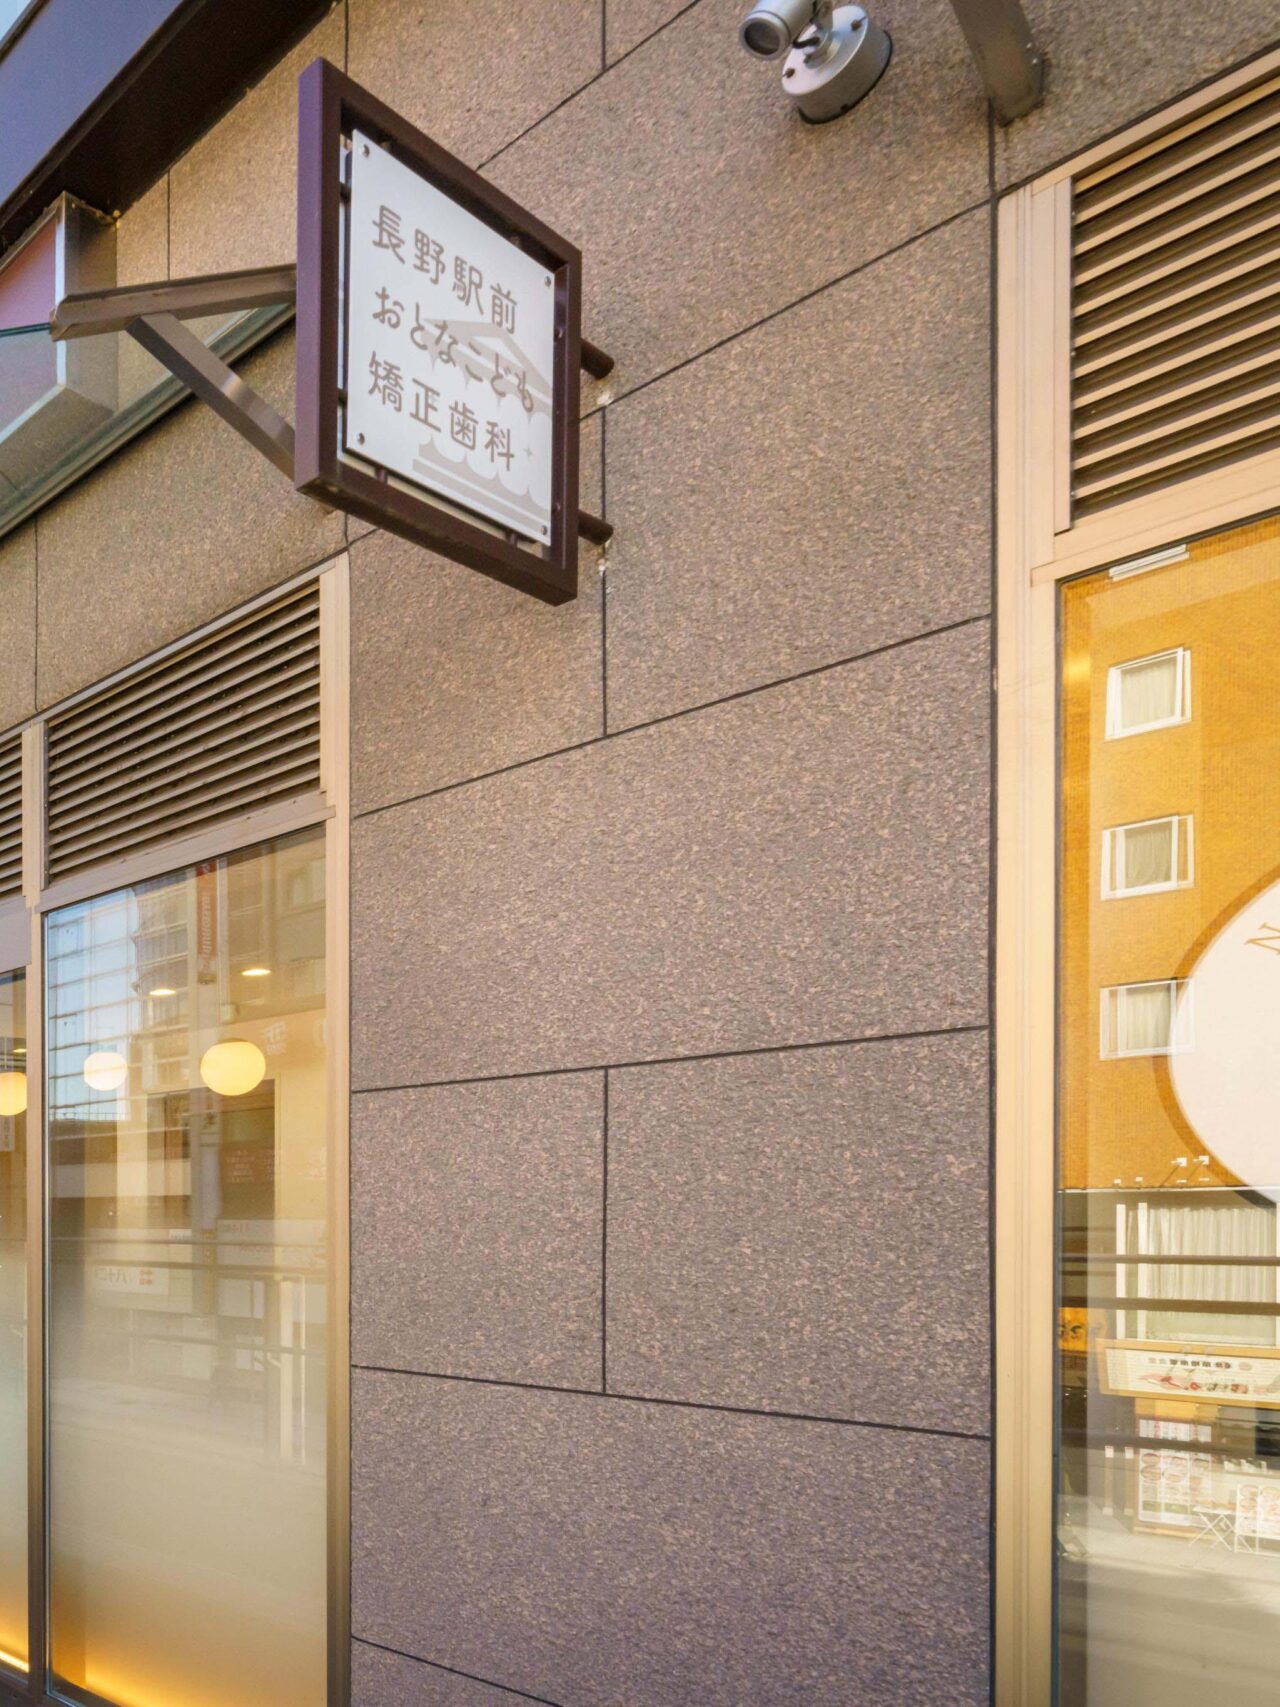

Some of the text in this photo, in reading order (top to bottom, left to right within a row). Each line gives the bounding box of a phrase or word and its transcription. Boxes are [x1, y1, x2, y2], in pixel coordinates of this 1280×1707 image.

[371, 204, 518, 335] 長野駅前
[368, 350, 515, 472] 矯正歯科
[373, 286, 535, 415] おとなこども
